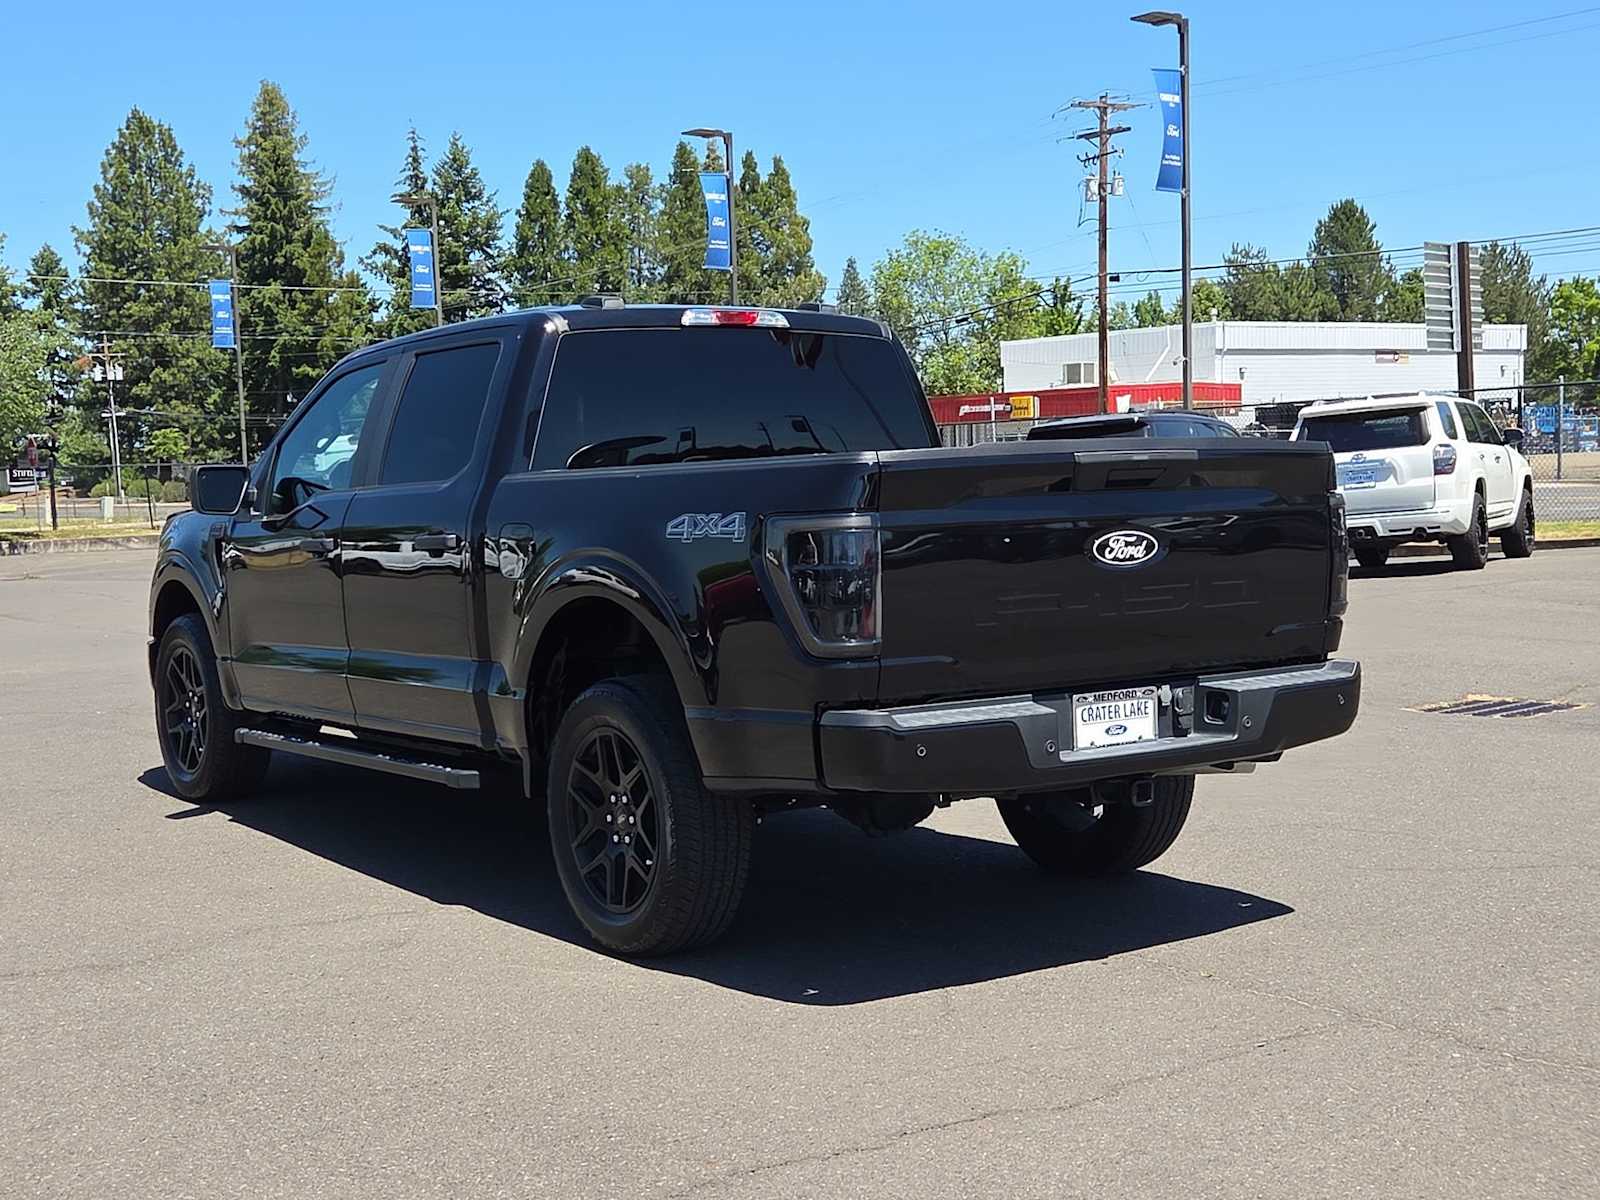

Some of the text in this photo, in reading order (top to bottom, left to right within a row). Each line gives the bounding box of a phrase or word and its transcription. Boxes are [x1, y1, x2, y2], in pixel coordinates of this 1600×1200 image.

[1105, 535, 1147, 559] Ford
[1093, 689, 1138, 702] MEDFORD
[1081, 701, 1150, 723] CRATER LAKE
